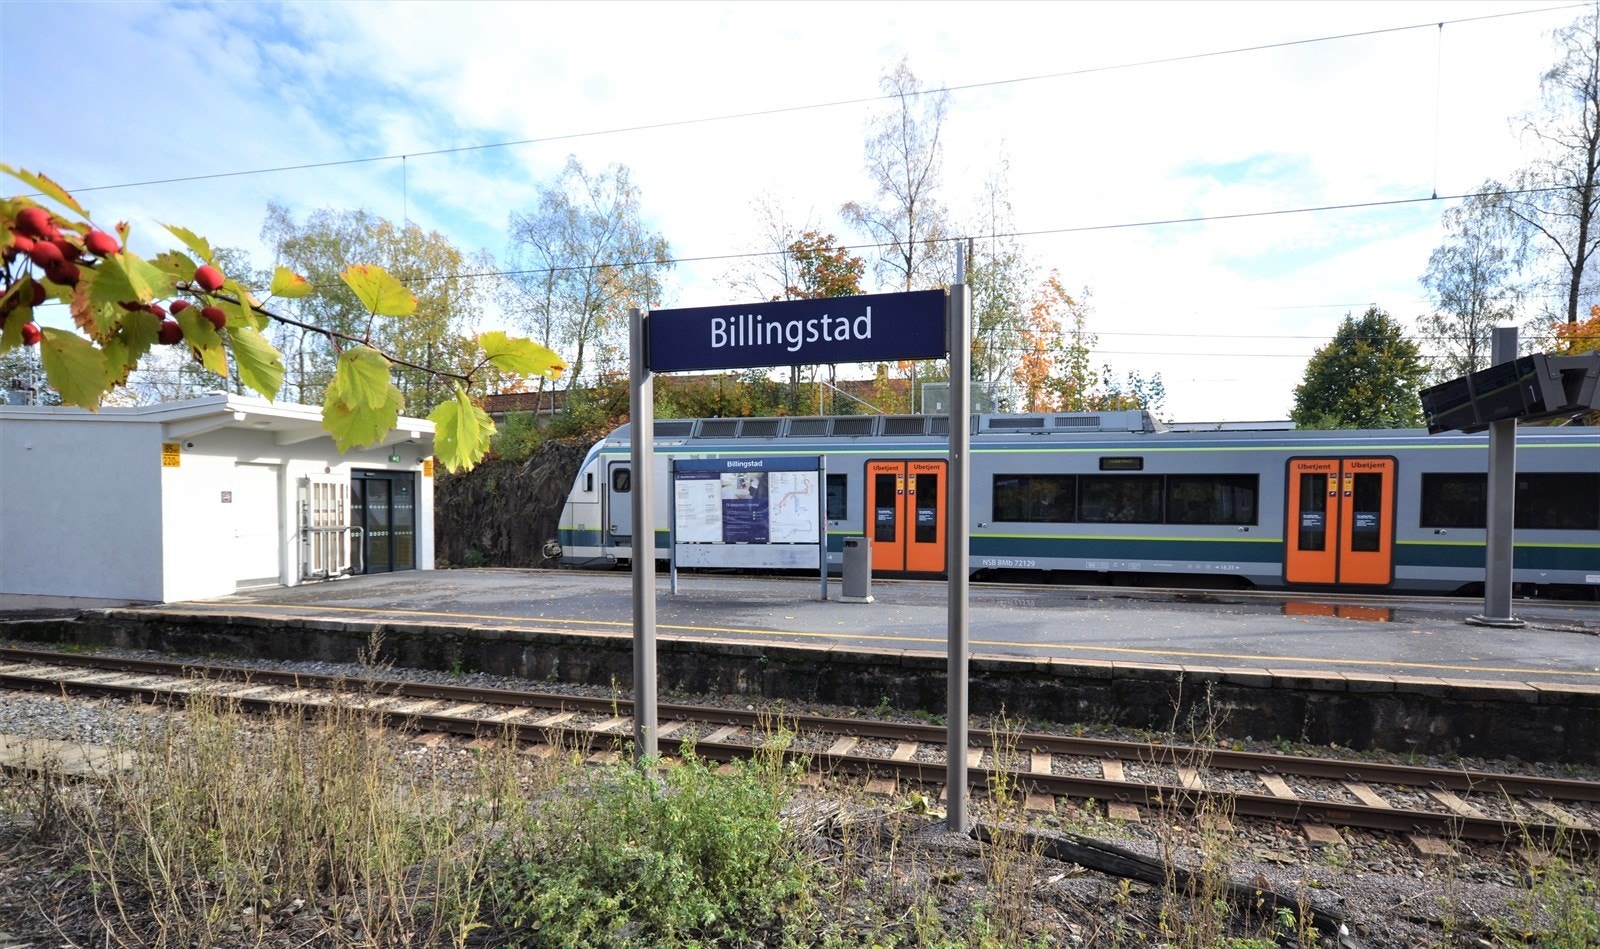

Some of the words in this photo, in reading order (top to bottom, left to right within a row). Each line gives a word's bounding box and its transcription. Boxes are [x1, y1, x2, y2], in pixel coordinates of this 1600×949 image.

[711, 306, 872, 352] Billingstad
[1529, 385, 1537, 402] 1
[727, 460, 763, 469] Billingstad
[1297, 463, 1331, 471] Ubetjent
[1351, 462, 1386, 470] Ubetjent
[1014, 559, 1036, 567] 72129
